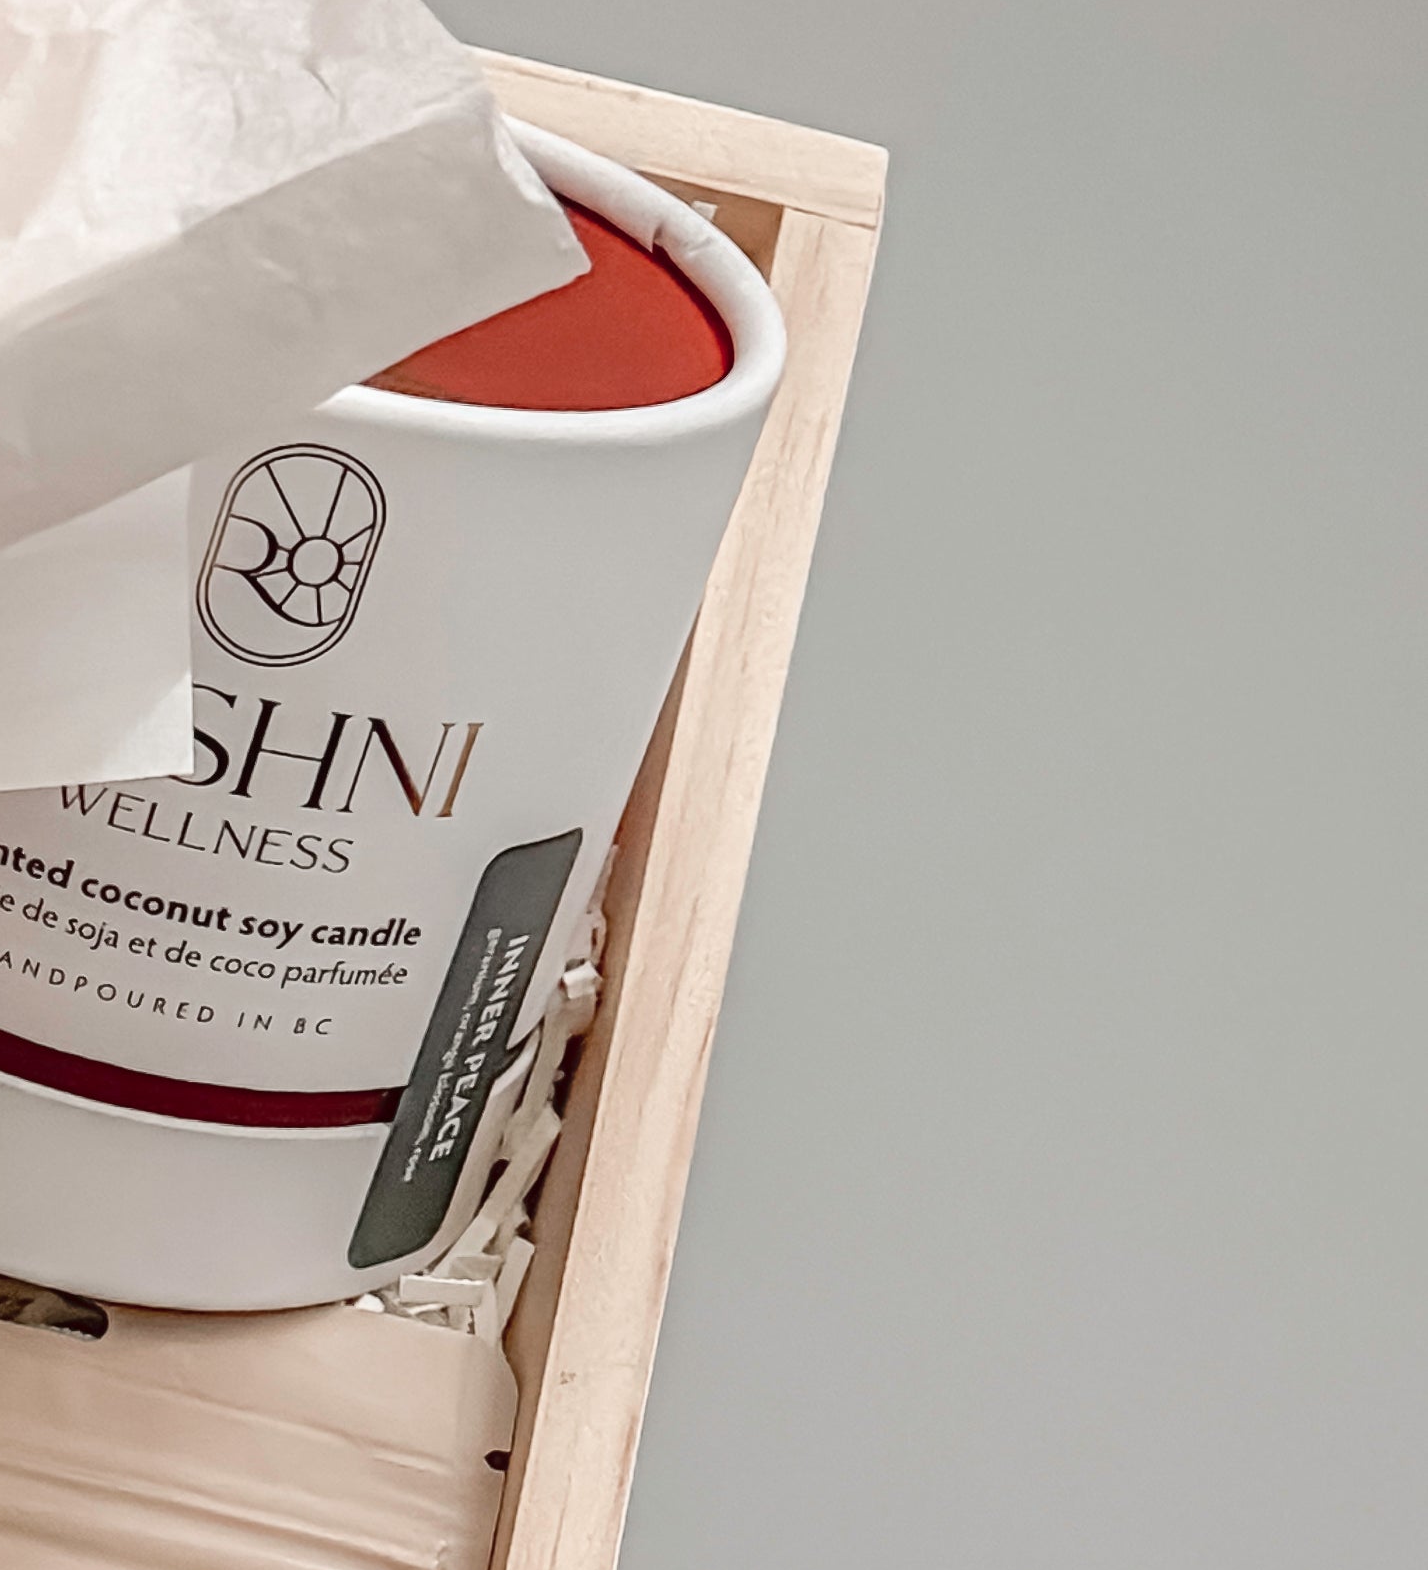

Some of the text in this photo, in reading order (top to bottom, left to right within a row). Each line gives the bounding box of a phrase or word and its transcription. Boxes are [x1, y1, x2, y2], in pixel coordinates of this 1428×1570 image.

[60, 784, 355, 874] WELLNESS
[21, 897, 59, 928] de
[64, 917, 119, 950] soja
[128, 937, 158, 958] et
[164, 940, 202, 968] de
[209, 955, 276, 979] coco
[280, 961, 409, 989] parfumée
[80, 877, 232, 932] coconut
[238, 915, 304, 950] soy
[310, 918, 422, 947] candle
[237, 1012, 273, 1031] IN
[293, 1017, 333, 1035] BC
[428, 934, 530, 1162] INNER PEACE
